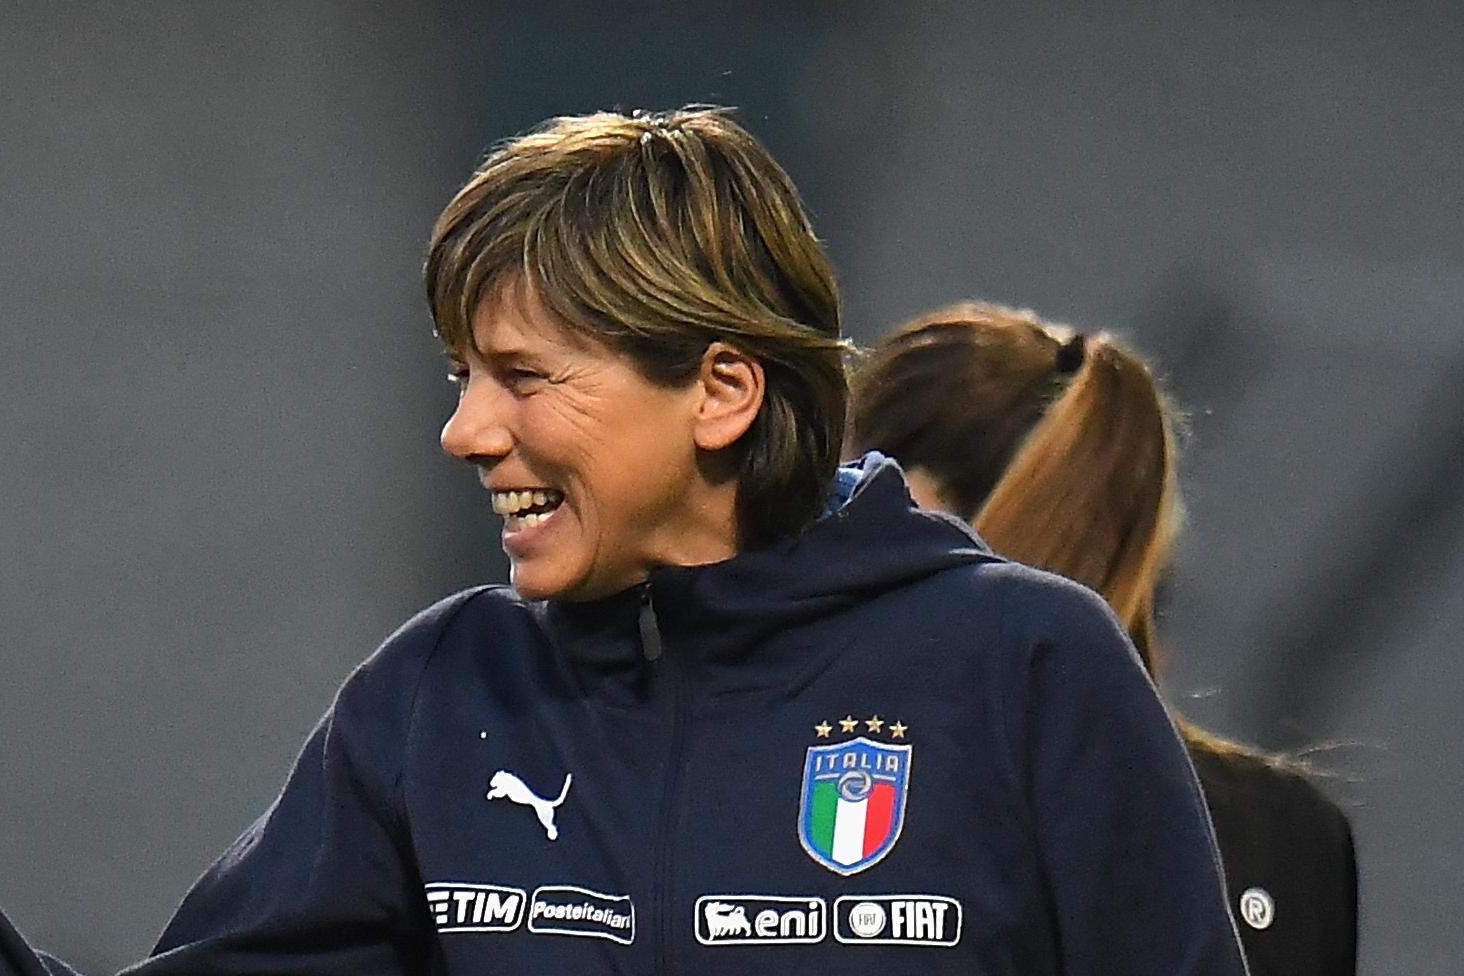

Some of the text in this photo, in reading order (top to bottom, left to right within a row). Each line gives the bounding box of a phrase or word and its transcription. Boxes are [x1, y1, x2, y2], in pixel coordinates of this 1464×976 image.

[815, 752, 900, 773] ITALIA
[452, 890, 519, 924] TIM
[754, 901, 819, 937] eni
[891, 900, 949, 940] FIAT
